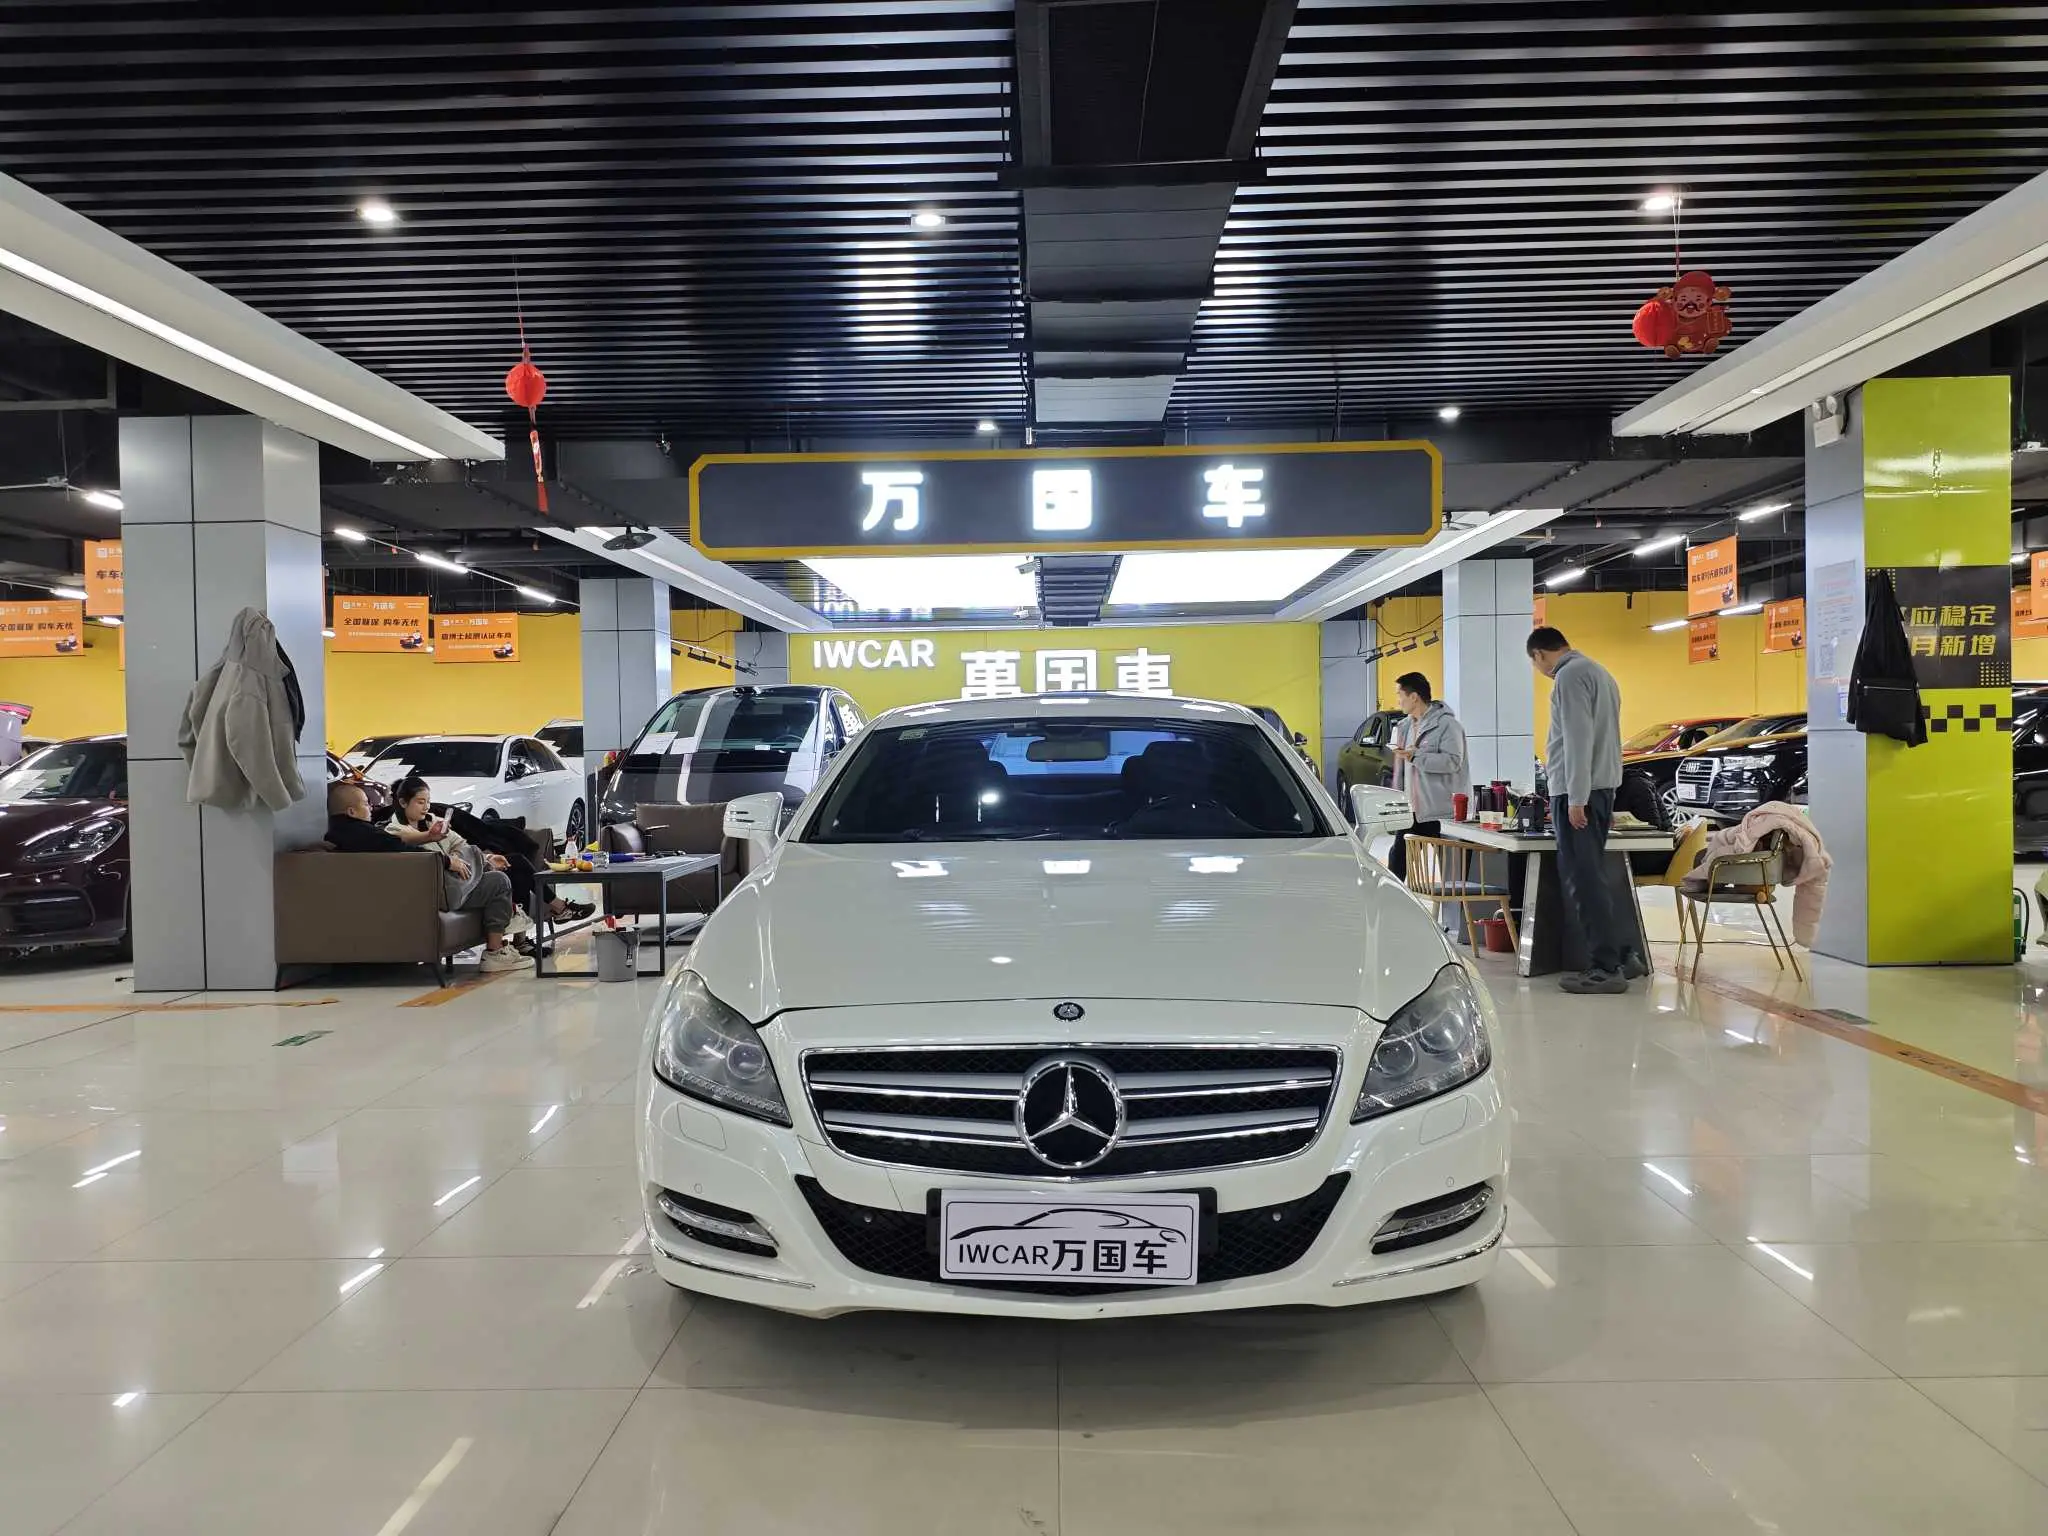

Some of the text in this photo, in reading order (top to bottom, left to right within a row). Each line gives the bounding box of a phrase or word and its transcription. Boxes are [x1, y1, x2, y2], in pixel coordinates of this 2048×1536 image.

[862, 464, 1266, 531] 万国车
[1900, 605, 1997, 628] 应稳定
[813, 639, 935, 669] IWCAR
